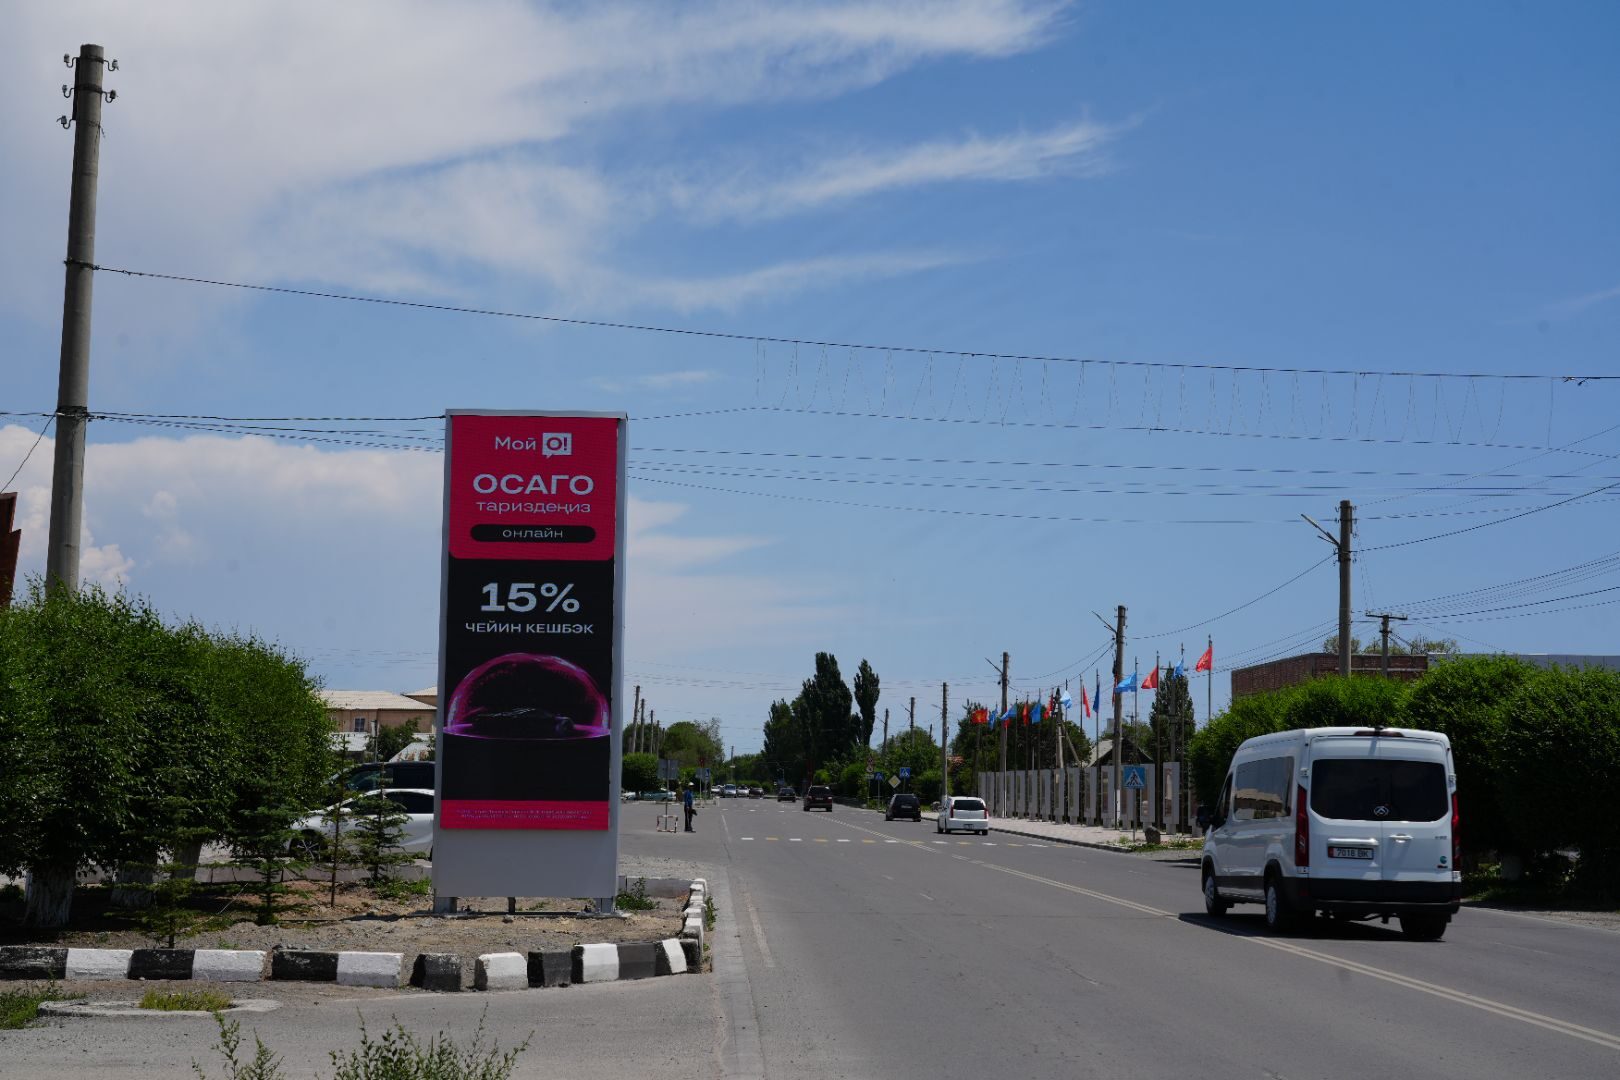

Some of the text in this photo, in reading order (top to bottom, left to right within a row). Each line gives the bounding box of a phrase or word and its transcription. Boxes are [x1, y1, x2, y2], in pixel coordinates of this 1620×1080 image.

[495, 436, 537, 451] Мой
[473, 473, 594, 496] ОСАГО
[476, 501, 591, 514] тариздеңиз
[502, 528, 563, 538] онлайн
[480, 582, 580, 613] 15%
[465, 620, 594, 634] ЧЕЙИН КЕШБЭК
